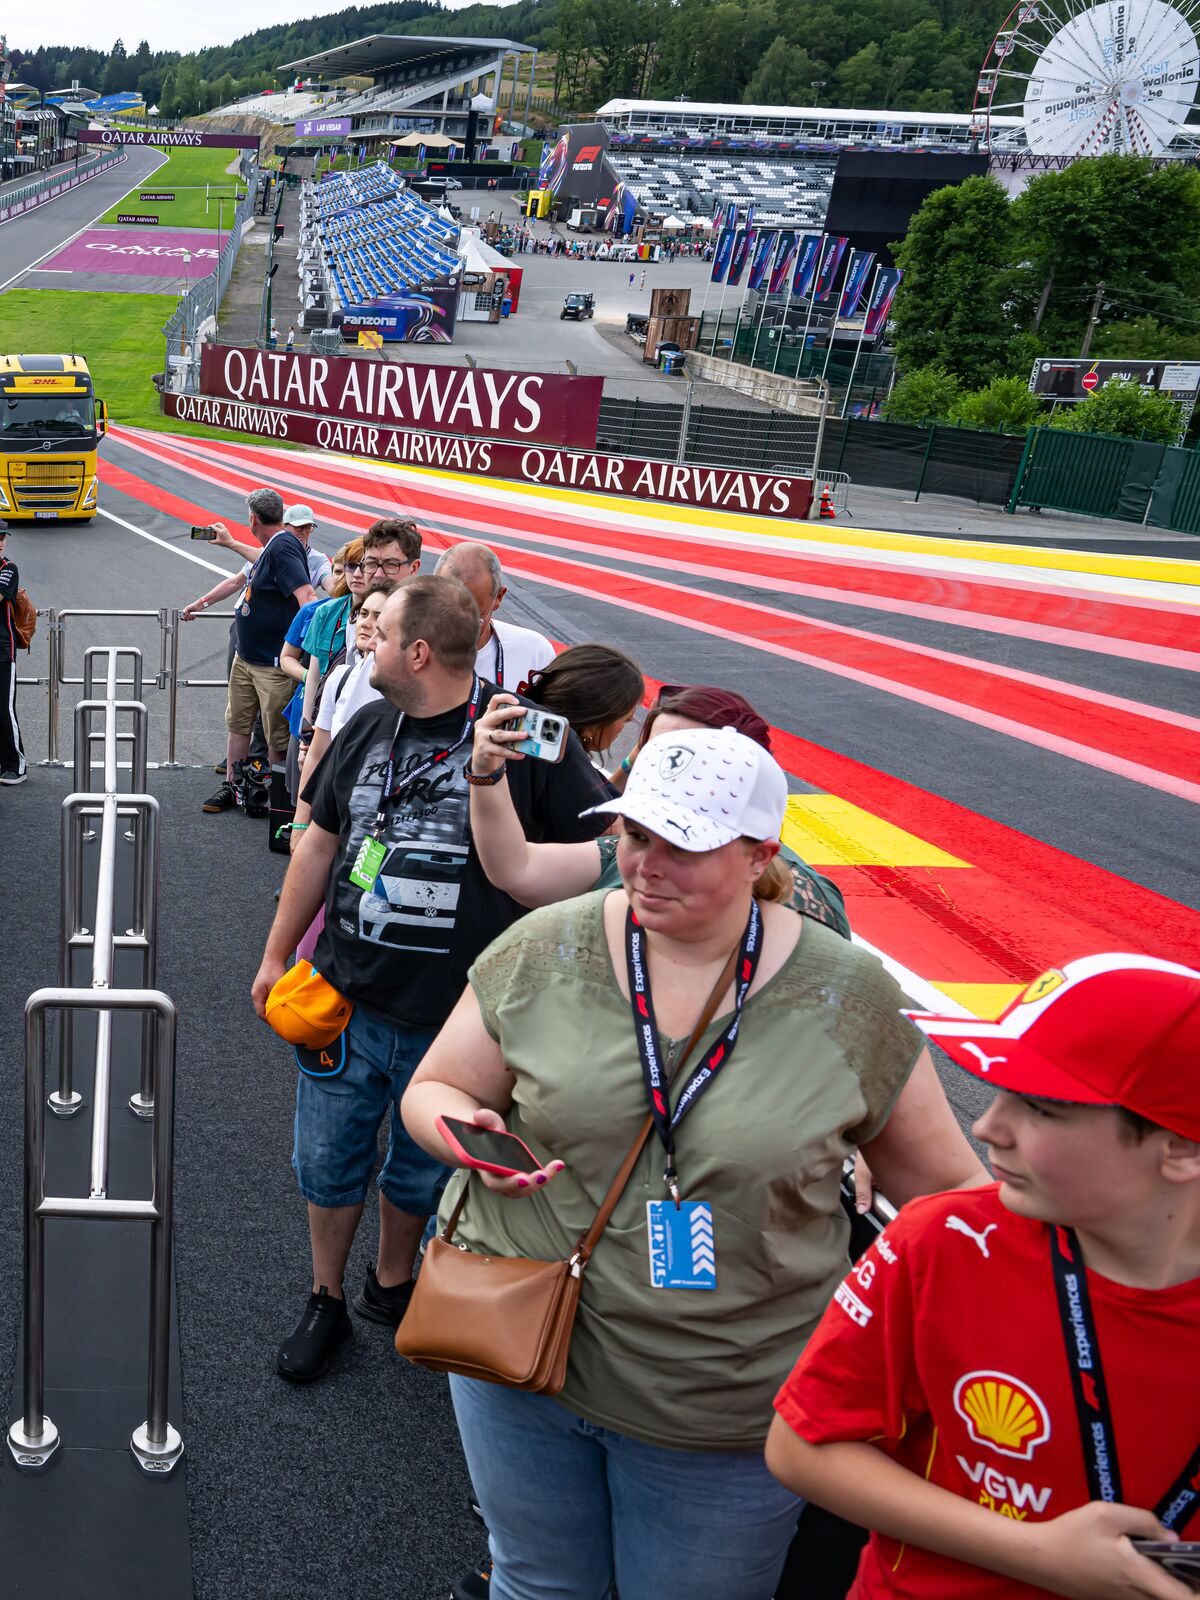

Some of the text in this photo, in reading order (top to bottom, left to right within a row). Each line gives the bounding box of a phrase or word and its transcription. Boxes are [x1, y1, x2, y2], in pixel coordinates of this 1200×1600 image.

[1116, 5, 1125, 64] wallonia
[1045, 95, 1096, 115] wallonia
[1142, 67, 1194, 87] wallonia
[101, 131, 202, 145] QATAR AIRWAYS
[316, 123, 342, 132] LAS VEGAS
[85, 243, 220, 255] QATAR
[175, 395, 289, 438] QATAR AIRWAYS
[224, 349, 544, 433] QATAR AIRWAYS
[316, 420, 493, 472] QATAR AIRWAYS
[521, 449, 792, 513] QATAR AIRWAYS
[746, 904, 759, 952] periences
[633, 932, 644, 992] Experiences
[643, 1024, 660, 1088] Experiences
[650, 1201, 667, 1286] STARTER
[1065, 1273, 1092, 1369] Experiences
[955, 1454, 1052, 1513] VGW
[1091, 1422, 1114, 1503] xperiences
